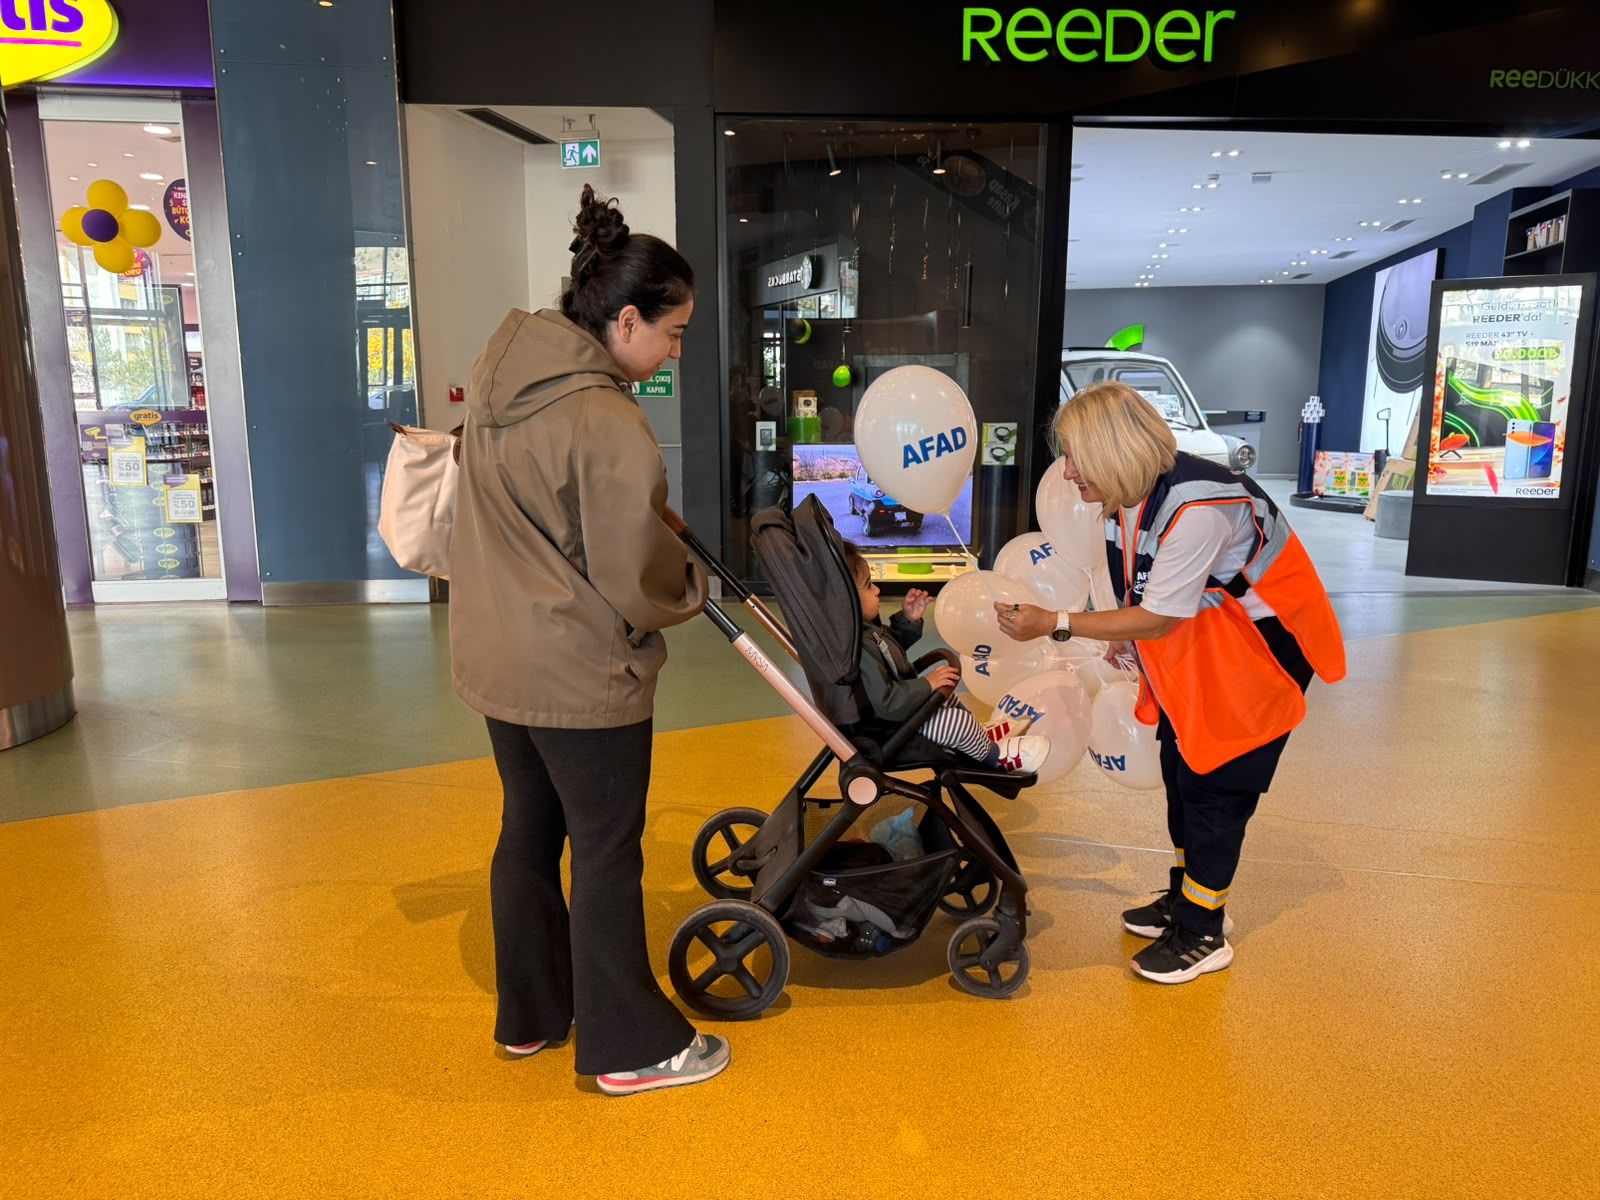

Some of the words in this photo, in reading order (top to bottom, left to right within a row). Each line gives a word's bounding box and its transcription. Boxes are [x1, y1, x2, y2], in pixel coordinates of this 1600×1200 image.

[1465, 331, 1499, 340] REEDER
[903, 426, 967, 469] AFAD
[1029, 542, 1053, 566] AF
[997, 694, 1047, 724] AFAD
